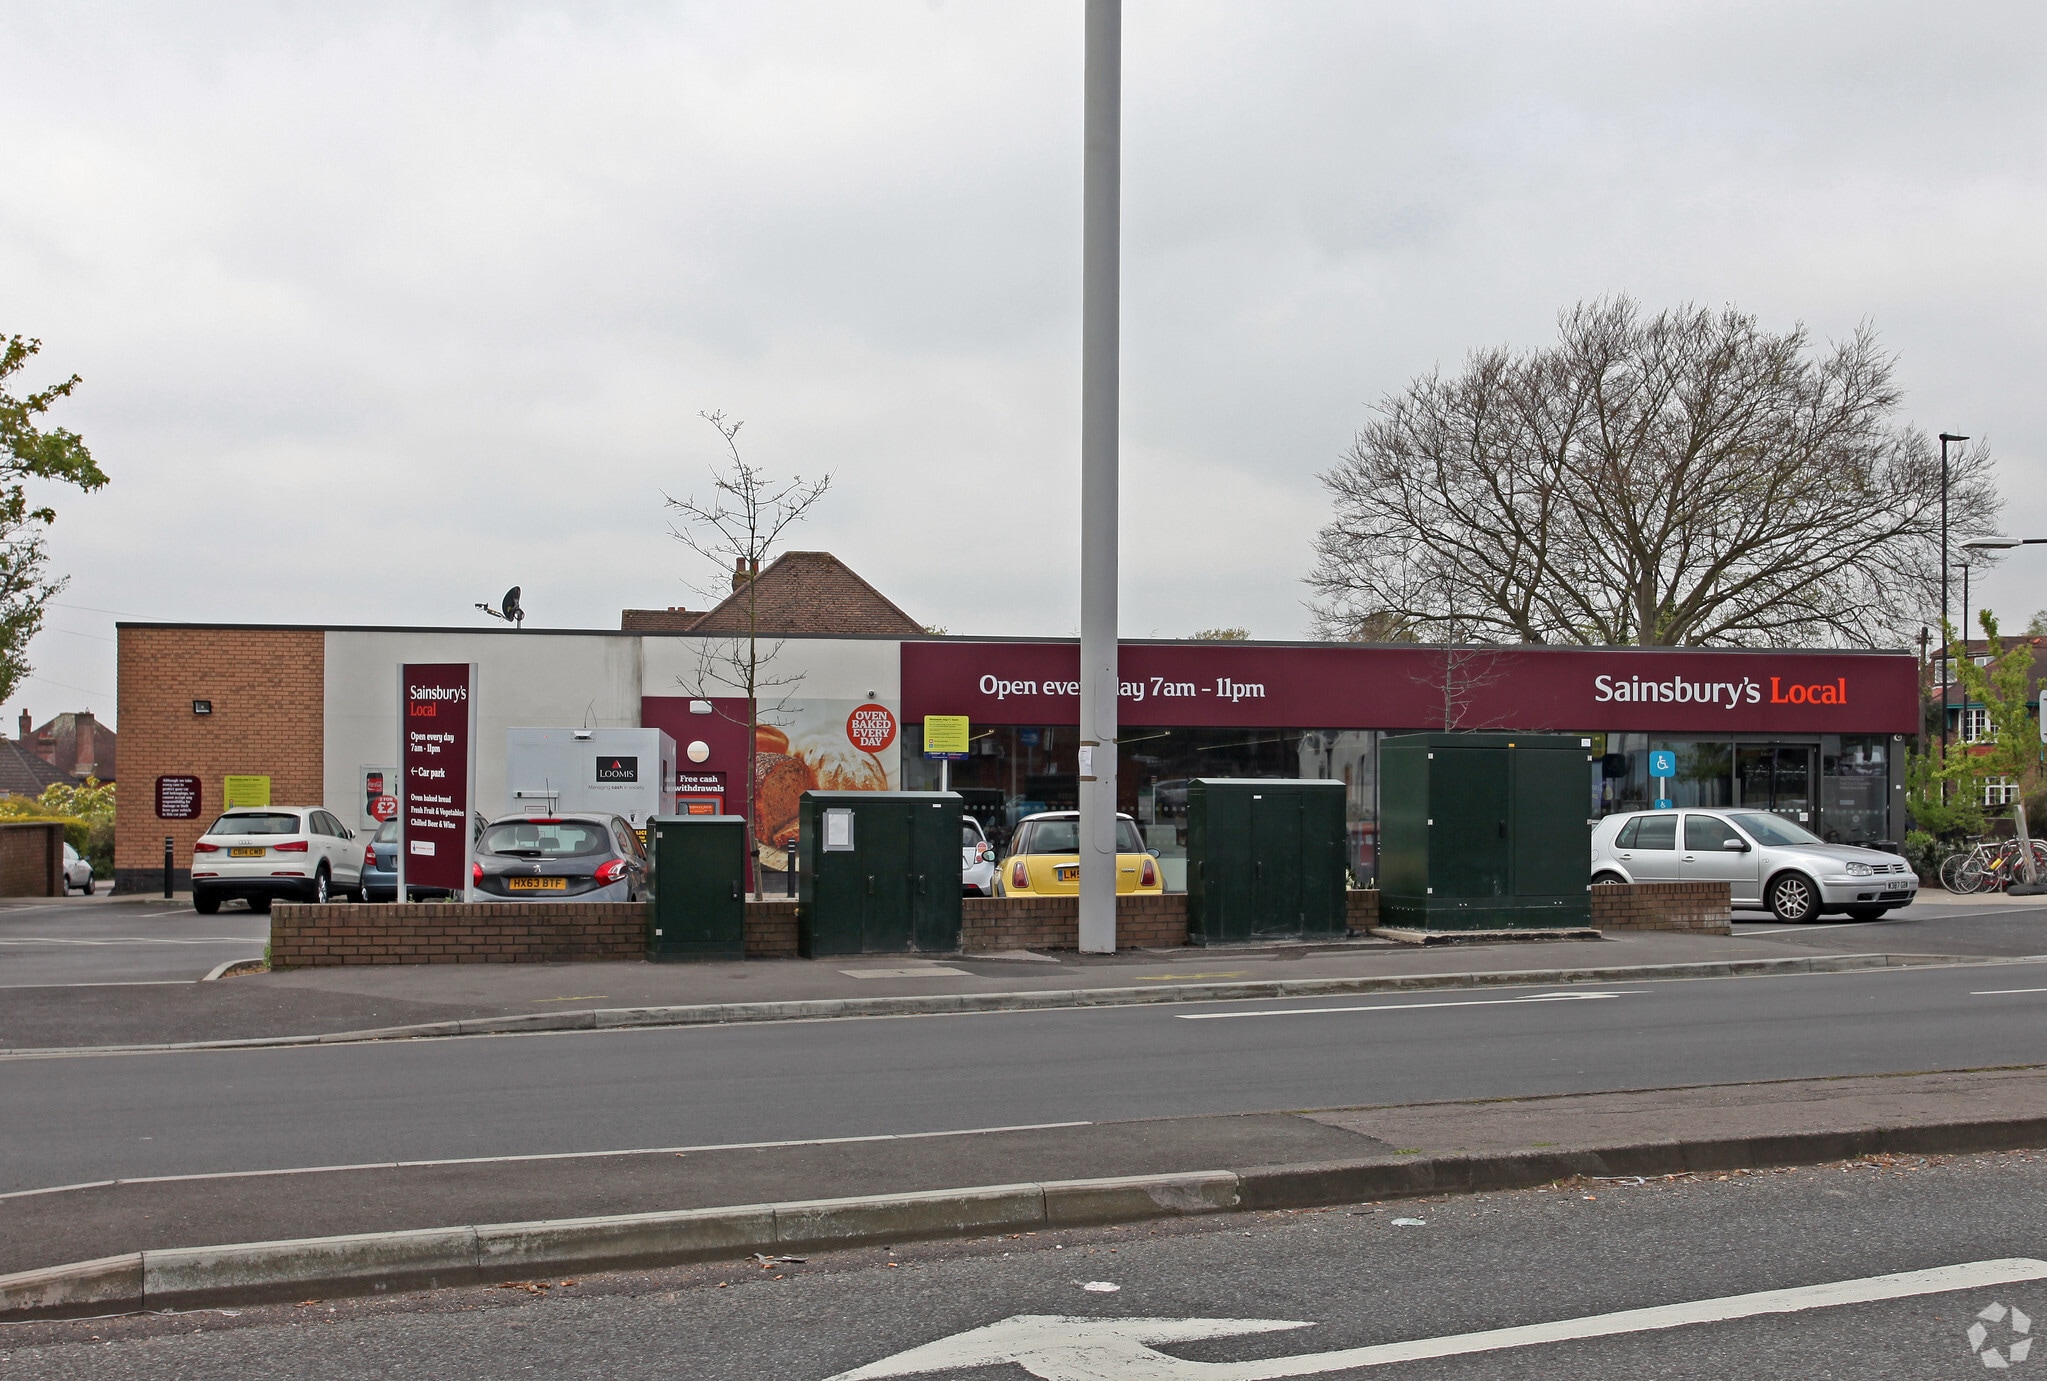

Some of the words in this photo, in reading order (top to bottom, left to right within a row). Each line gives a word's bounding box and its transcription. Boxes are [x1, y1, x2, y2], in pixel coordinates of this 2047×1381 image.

[410, 685, 467, 703] Sainsbury's
[979, 674, 1037, 700] Open
[1042, 680, 1081, 696] eve
[1117, 677, 1145, 701] ay
[1150, 676, 1197, 697] 7am
[1216, 677, 1266, 703] 11pm
[1594, 674, 1761, 709] Sainsbury's
[1770, 676, 1847, 704] Local
[410, 701, 436, 717] Local
[855, 711, 888, 720] OVEN
[852, 720, 891, 729] BAKED
[410, 731, 426, 743] Open
[426, 734, 443, 743] every
[443, 732, 455, 743] day
[853, 729, 890, 738] EVERY
[860, 738, 883, 746] DAY
[410, 743, 423, 752] 7am
[427, 744, 441, 755] 11pm
[418, 766, 429, 777] Car
[430, 768, 445, 780] park
[600, 770, 634, 778] LOOMIS
[680, 774, 698, 783] Free
[699, 775, 718, 783] cash
[674, 784, 725, 792] withdrawals
[423, 794, 437, 803] baked
[438, 795, 451, 803] bread
[377, 801, 396, 814] £2
[410, 806, 423, 814] Fresh
[424, 806, 435, 815] Fruit
[440, 808, 464, 817] Vegetables
[410, 818, 427, 827] Chilled
[428, 820, 438, 828] Beer
[440, 820, 443, 828] &
[444, 820, 456, 829] Wine
[514, 879, 540, 887] HX63
[543, 879, 562, 887] BTF
